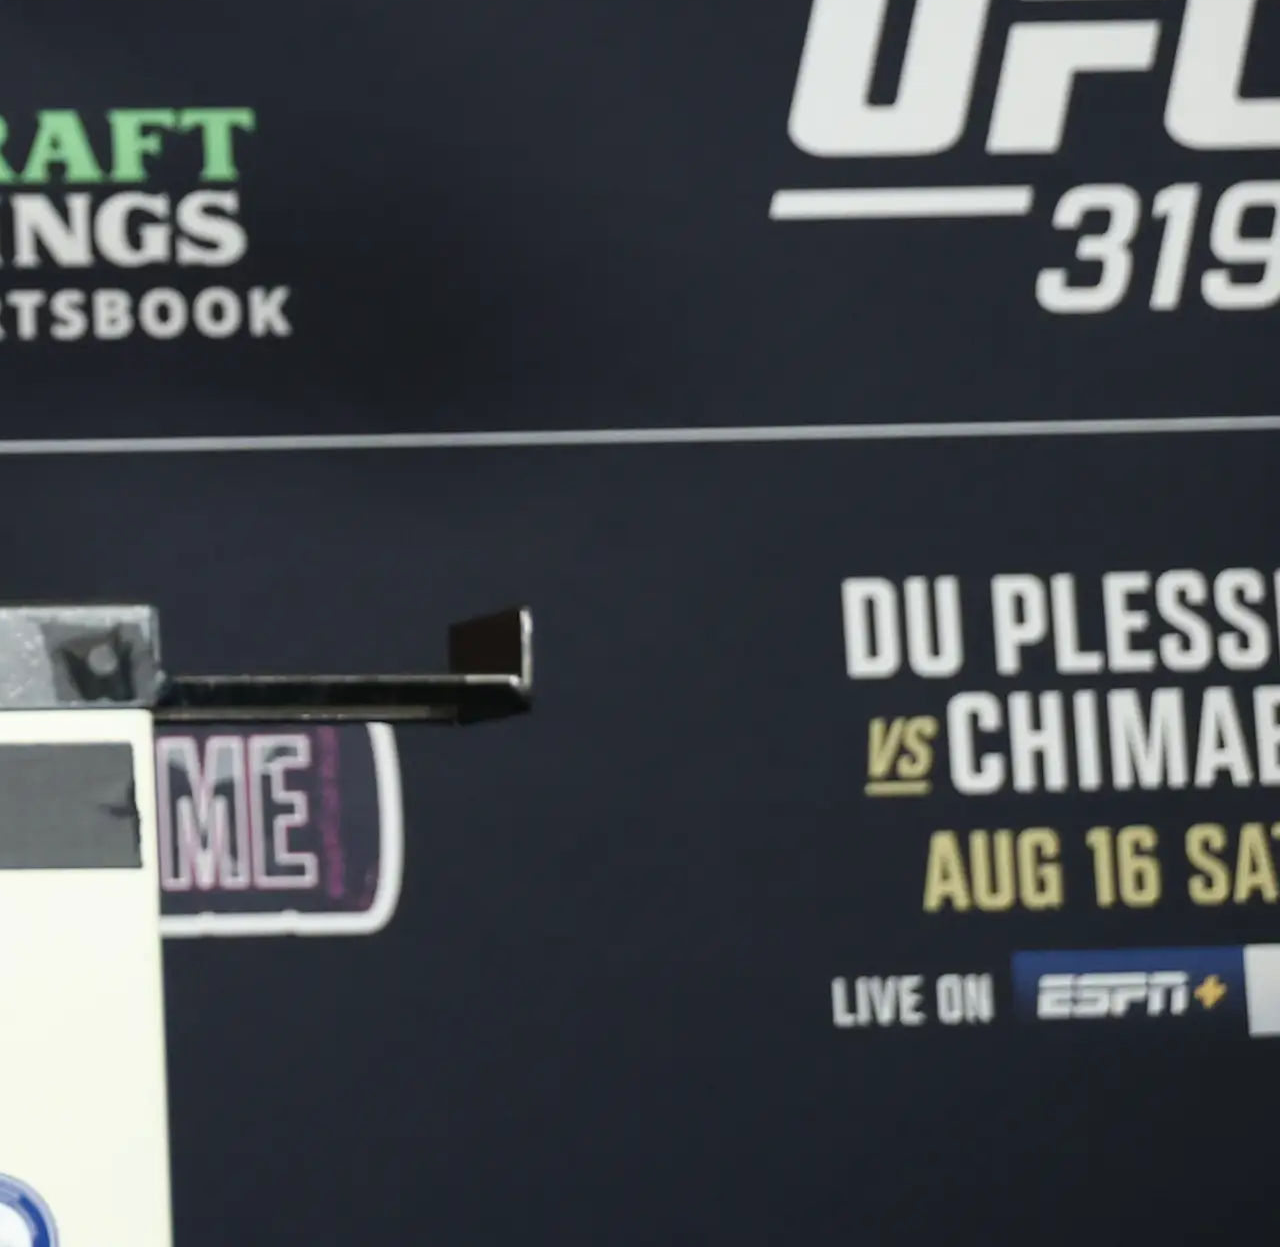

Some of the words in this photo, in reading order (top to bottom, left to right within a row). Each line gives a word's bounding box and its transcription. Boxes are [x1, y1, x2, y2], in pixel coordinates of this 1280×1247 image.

[1034, 178, 1280, 315] 319
[840, 574, 966, 680] DU
[867, 714, 940, 781] VS
[921, 826, 1066, 914] AUG
[1084, 823, 1162, 909] 16
[1183, 822, 1280, 906] SA
[830, 974, 927, 1029] LIVE
[935, 972, 996, 1026] ON
